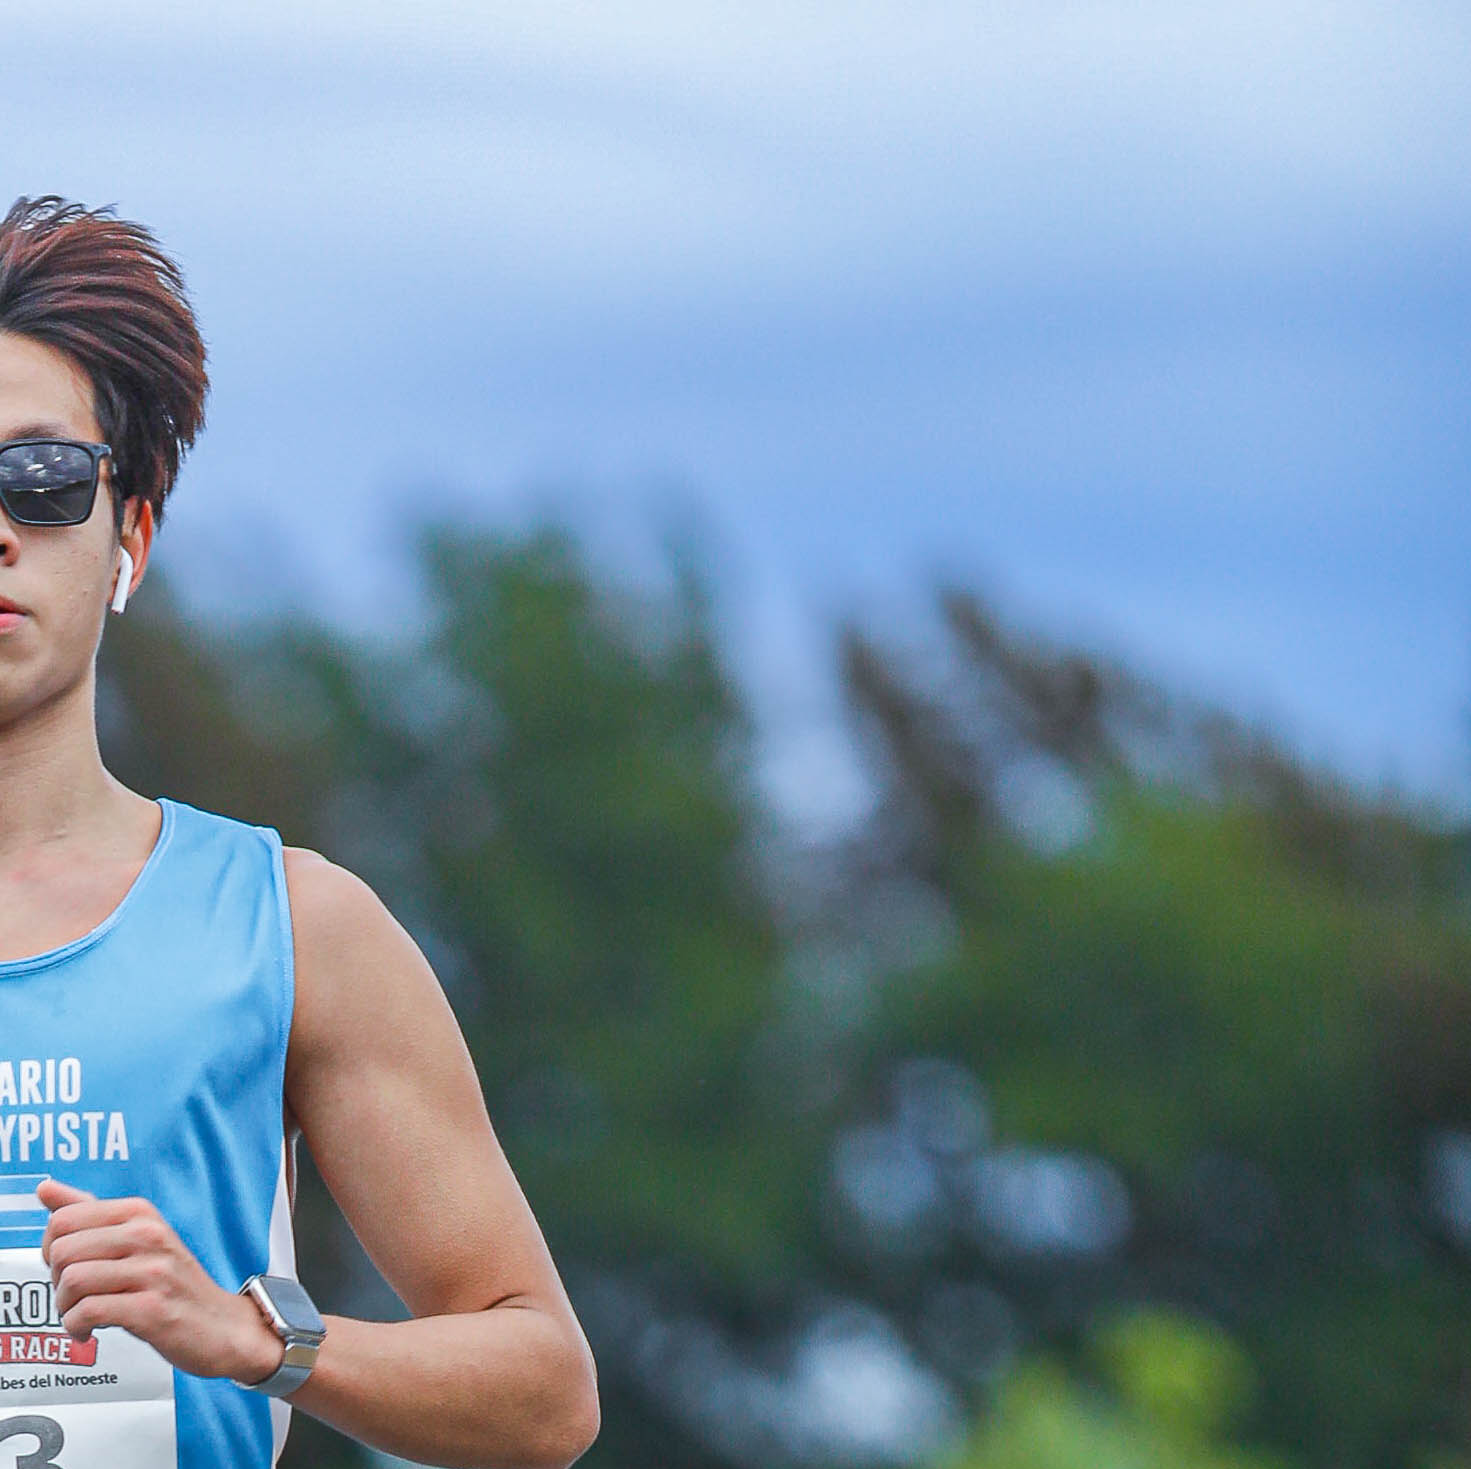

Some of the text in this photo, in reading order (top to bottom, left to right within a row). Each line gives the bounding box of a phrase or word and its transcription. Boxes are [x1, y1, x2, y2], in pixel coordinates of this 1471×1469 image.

[10, 1334, 73, 1363] RACE
[29, 1374, 52, 1388] del
[55, 1373, 119, 1387] Noroeste
